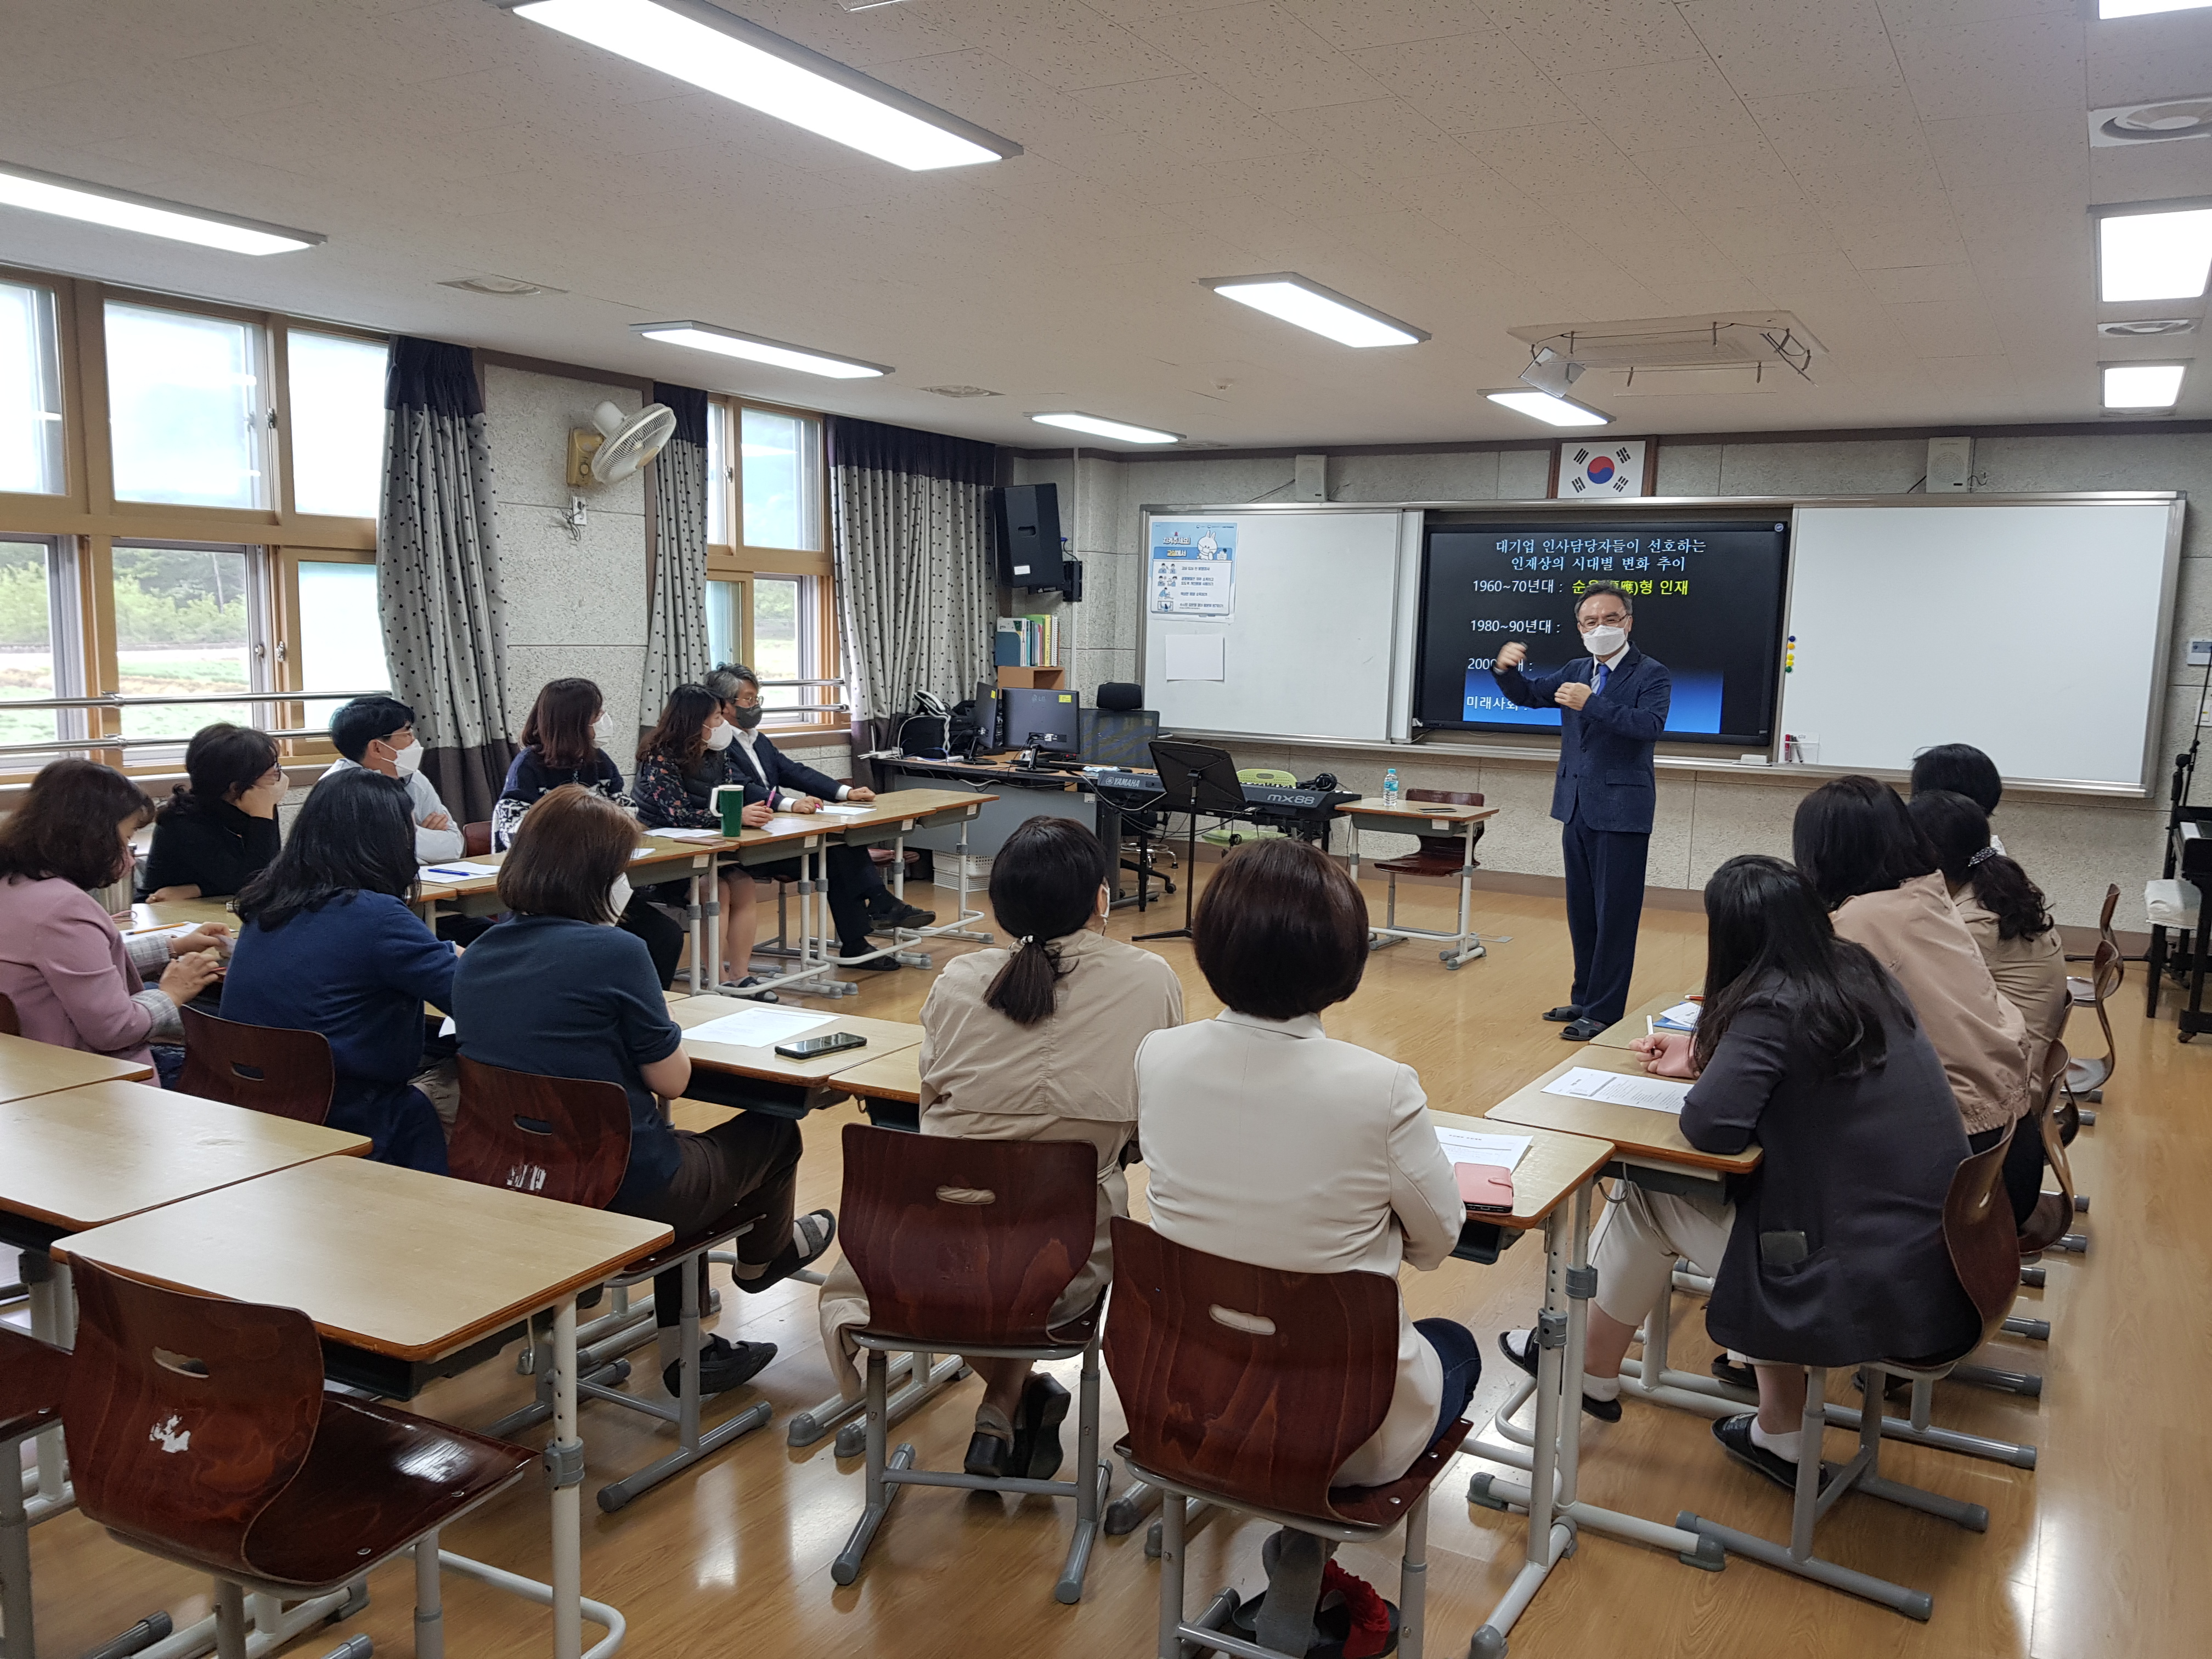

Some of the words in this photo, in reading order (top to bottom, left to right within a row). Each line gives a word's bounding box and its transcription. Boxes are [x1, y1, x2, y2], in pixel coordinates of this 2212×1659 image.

[1496, 539, 1534, 554] 대기업
[1543, 538, 1639, 554] 인사담당자들이
[1647, 538, 1706, 554] 선호하는
[1511, 556, 1564, 571] 인재상의
[1573, 556, 1613, 571] 시대별
[1622, 556, 1650, 571] 변화
[1657, 556, 1685, 572] 추이
[1473, 579, 1554, 594] 1960~70년대
[1660, 580, 1688, 595] 인재
[1471, 619, 1551, 634] 1980~90년대
[1466, 696, 1518, 711] 미래사회
[1114, 777, 1141, 788] YAMAHA
